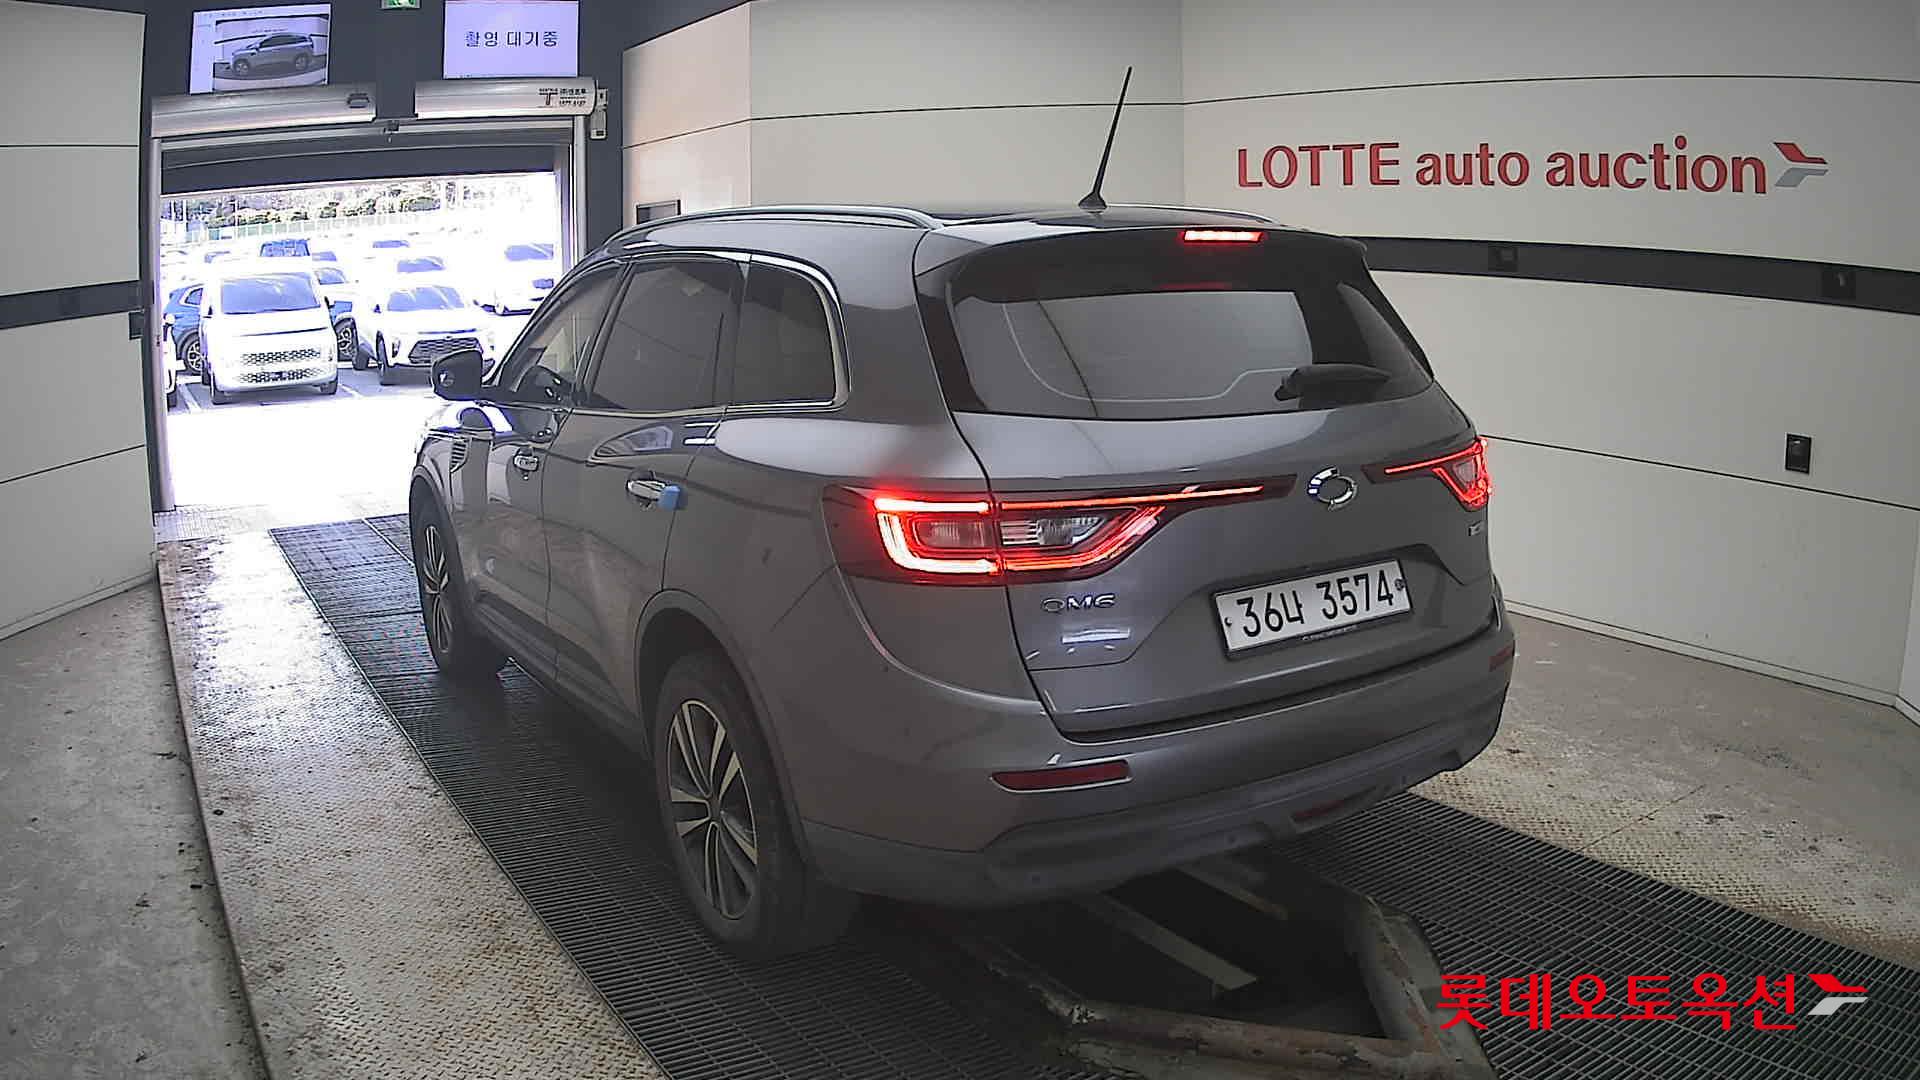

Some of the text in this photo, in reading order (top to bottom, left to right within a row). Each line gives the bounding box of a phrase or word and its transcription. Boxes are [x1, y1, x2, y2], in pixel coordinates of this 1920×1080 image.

[506, 31, 558, 48] 대기중
[1237, 135, 1767, 194] LOTTE auto auction
[1236, 568, 1394, 638] 36나 3574
